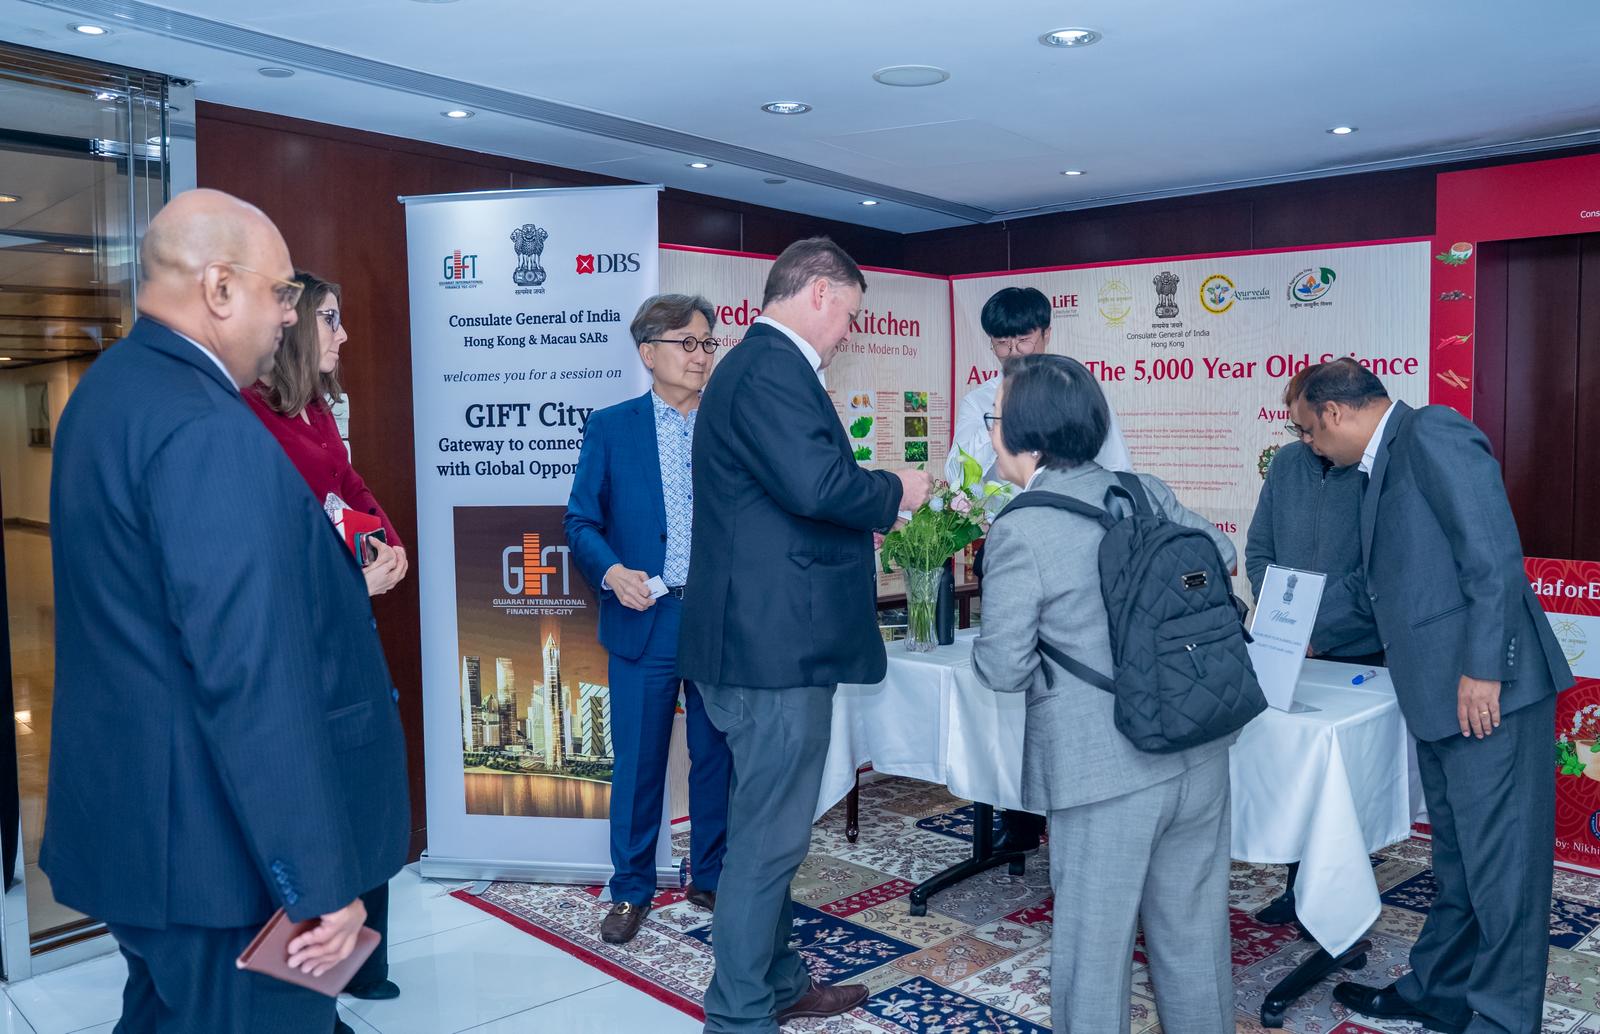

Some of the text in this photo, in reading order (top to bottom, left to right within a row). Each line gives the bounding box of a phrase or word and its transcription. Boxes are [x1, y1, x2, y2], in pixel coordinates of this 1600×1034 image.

[443, 249, 478, 280] GIFT
[597, 252, 641, 274] DBS
[1052, 294, 1079, 309] LiFE
[449, 309, 621, 328] Consulate General of India
[464, 332, 608, 349] Hong Kong & Macau SARs
[1126, 329, 1210, 340] Consulate General of India
[851, 343, 865, 353] the
[868, 344, 900, 355] Modern
[902, 345, 918, 358] Day
[1151, 340, 1185, 349] Hong Kong
[443, 367, 622, 384] welcomes you for a session on
[1086, 360, 1126, 381] The
[1134, 358, 1194, 384] 5,000
[1203, 357, 1257, 379] Year
[1266, 354, 1309, 377] Old
[465, 402, 593, 434] GIFT City
[439, 438, 583, 455] Gateway to connec
[437, 461, 470, 476] with
[475, 460, 525, 476] Global
[502, 533, 571, 596] GIFT
[506, 608, 573, 616] FINANCE TEC-CITY
[1555, 838, 1600, 855] by: Nikhi
